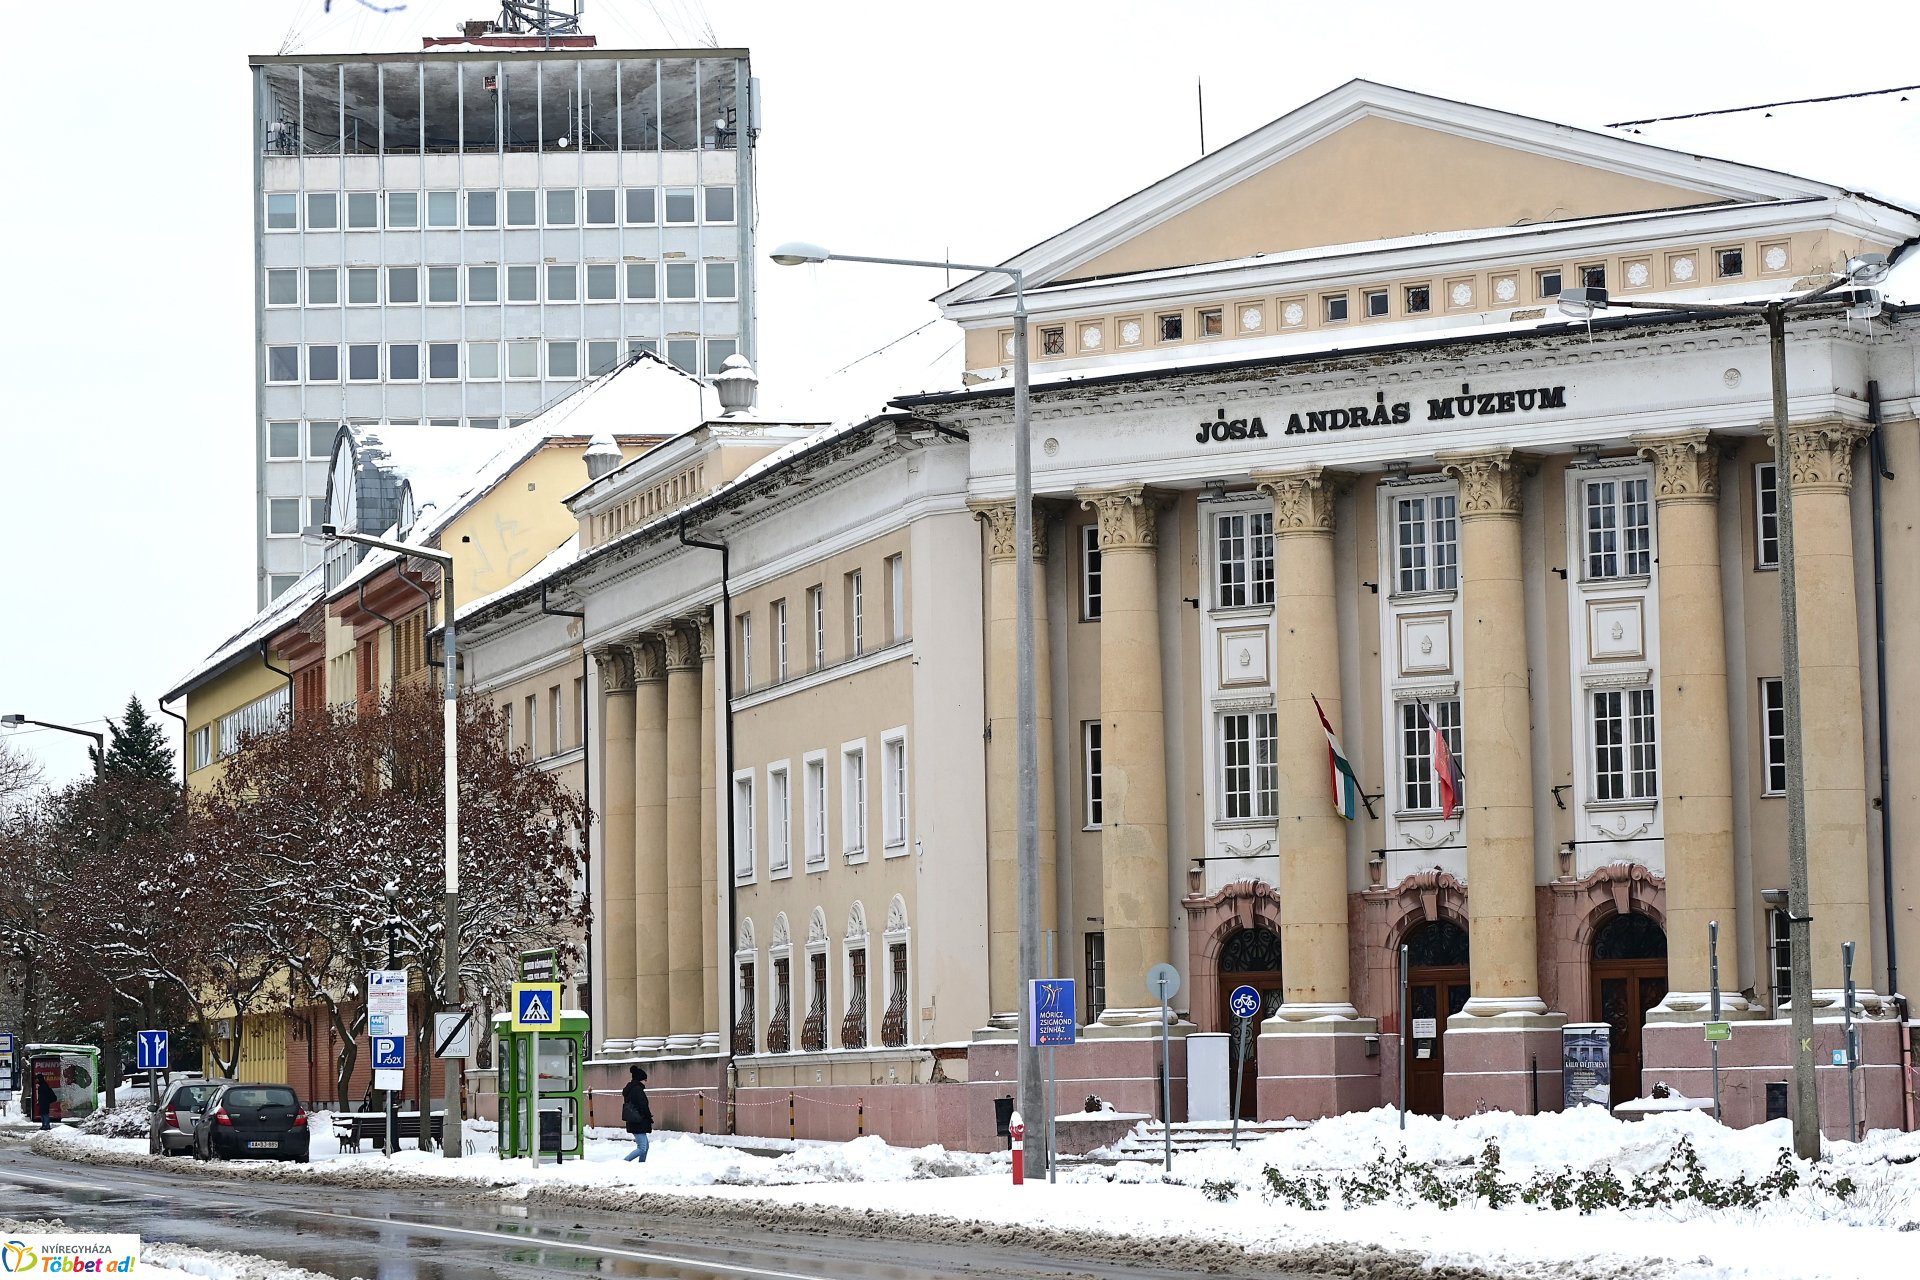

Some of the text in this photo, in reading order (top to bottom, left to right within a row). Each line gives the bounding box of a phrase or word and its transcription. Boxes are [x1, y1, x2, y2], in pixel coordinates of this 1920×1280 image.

[1196, 383, 1566, 443] JÓSA ANDRÁS MÚZEUM
[1040, 1011, 1063, 1019] MÓRICZ
[1802, 1037, 1812, 1052] K
[35, 1061, 61, 1069] PENNY
